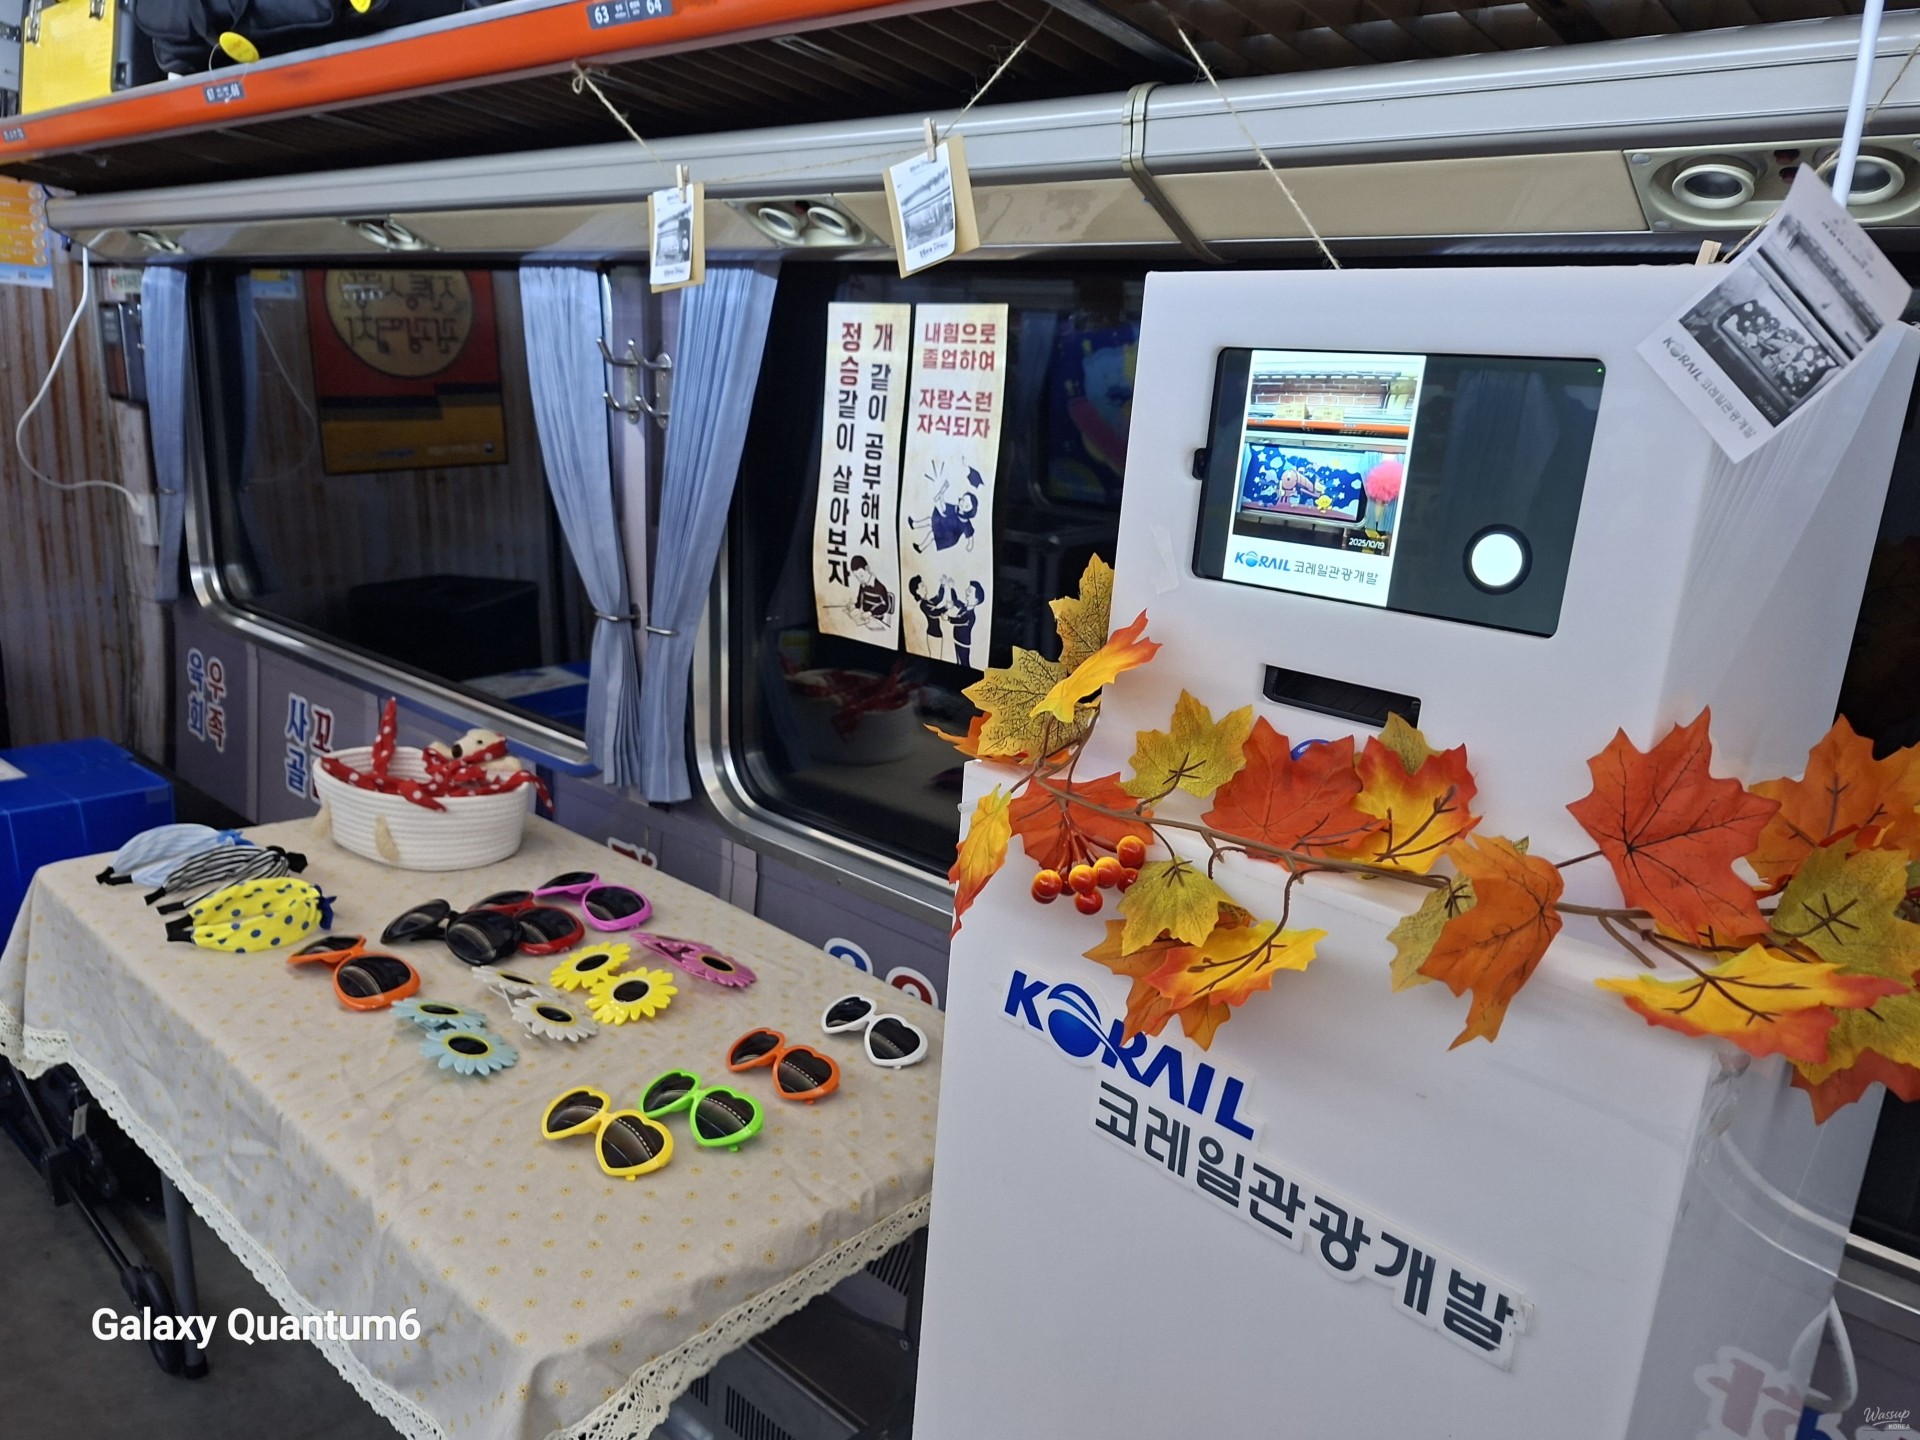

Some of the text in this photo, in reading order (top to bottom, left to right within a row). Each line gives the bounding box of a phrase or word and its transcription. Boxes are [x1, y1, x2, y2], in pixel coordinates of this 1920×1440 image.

[594, 5, 610, 25] 63
[646, 0, 662, 15] 64
[924, 323, 996, 345] 내힘으로
[922, 348, 996, 372] 졸업하여
[1662, 336, 1703, 382] KORAIL
[919, 388, 993, 413] 자랑스런
[860, 323, 894, 549] 개 같이 공부해서
[916, 413, 991, 439] 자식되자
[827, 322, 862, 587] 정승같이 살아보자
[1348, 537, 1385, 549] 2025/10/19
[1234, 550, 1379, 586] KORAIL 코레일관광개발
[287, 698, 308, 793] 사골
[1004, 969, 1255, 1141] KORAIL
[1095, 1080, 1515, 1352] 코레일관광개발
